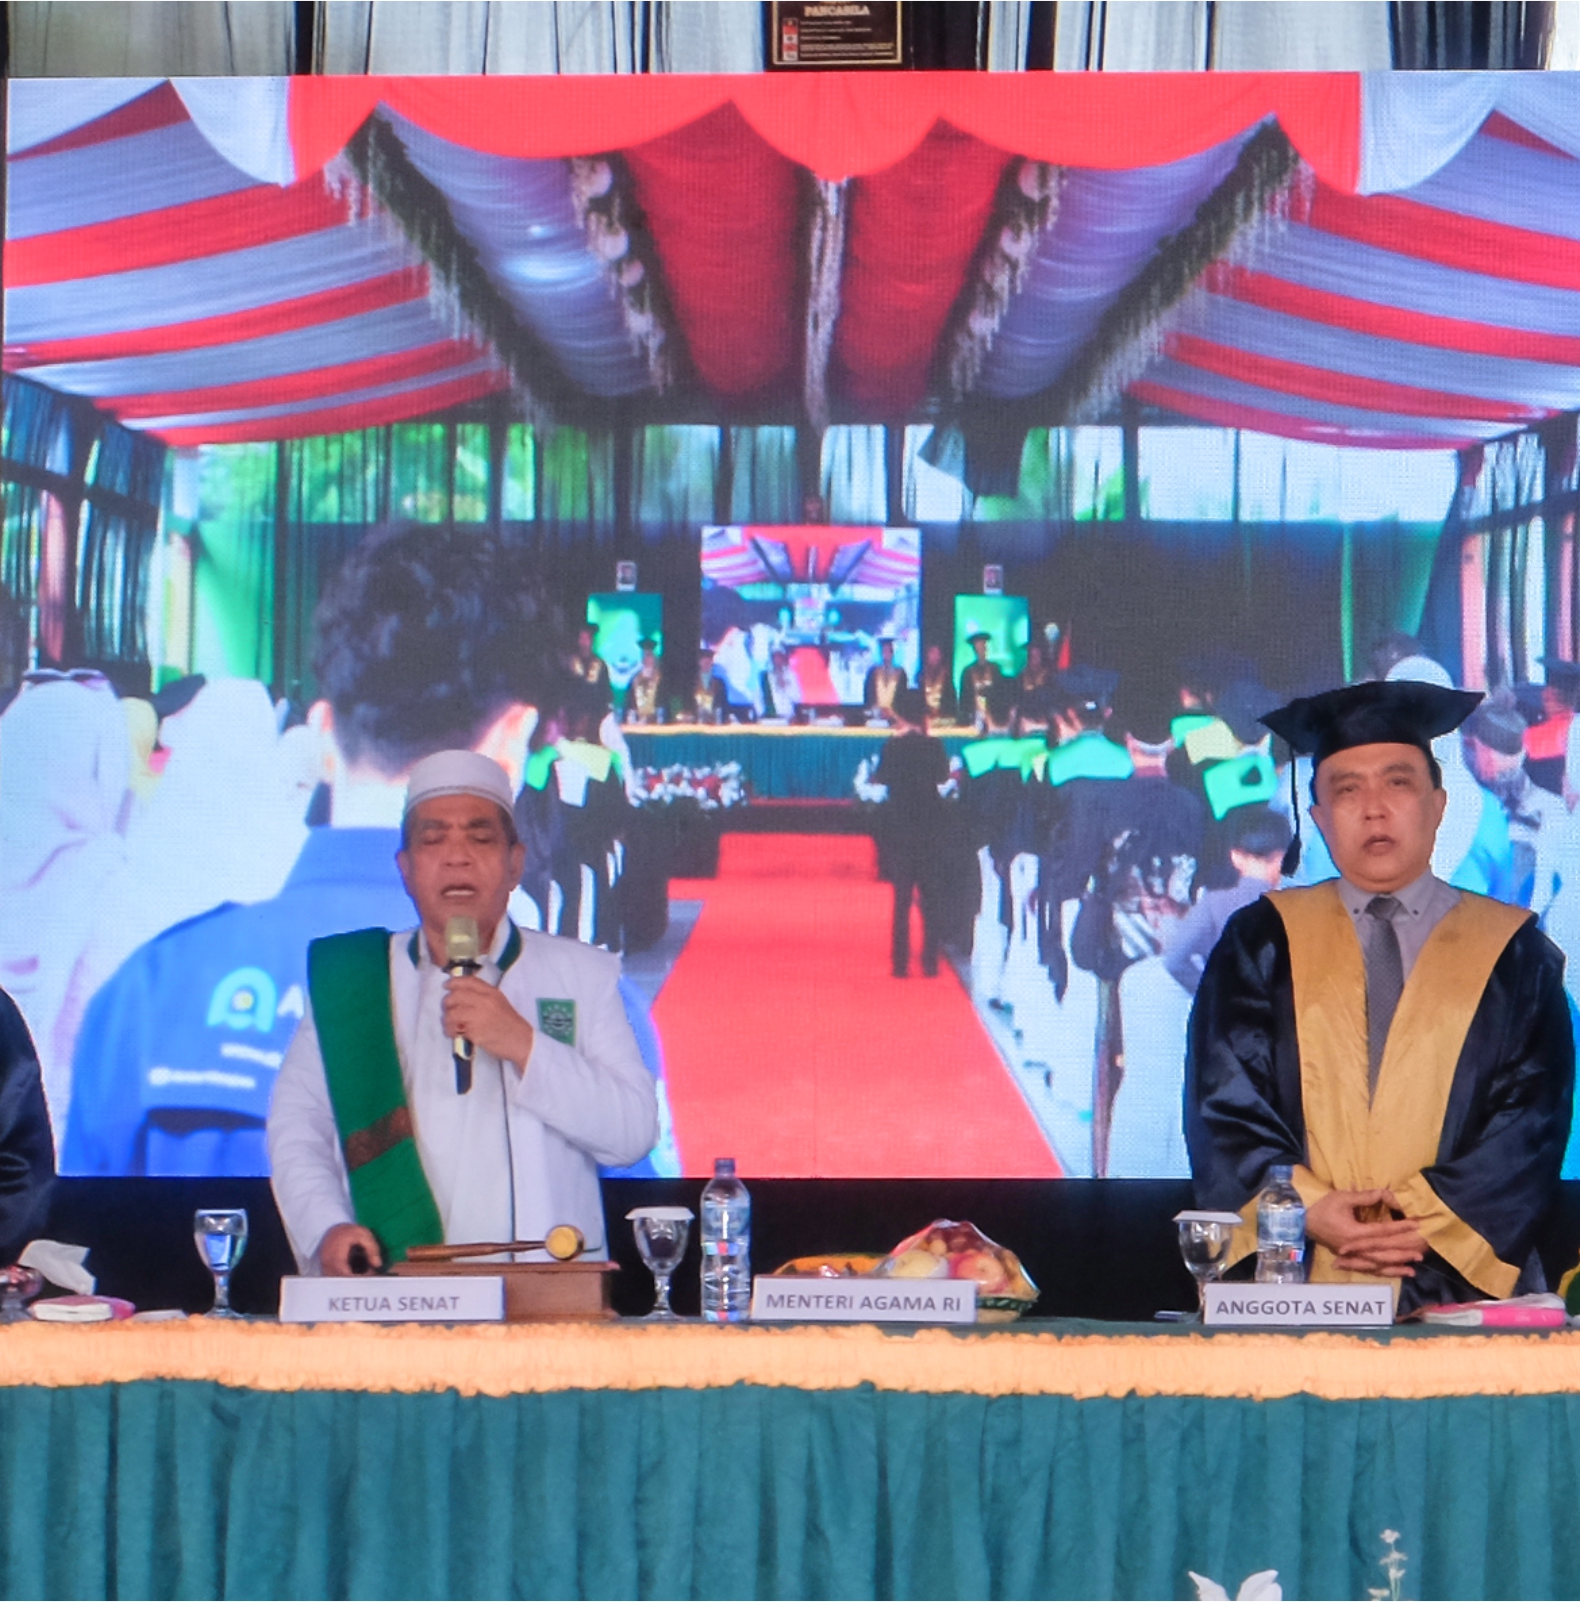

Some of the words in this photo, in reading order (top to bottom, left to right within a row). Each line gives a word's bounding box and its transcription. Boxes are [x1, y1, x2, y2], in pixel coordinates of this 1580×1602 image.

[328, 1296, 392, 1312] KETUA
[398, 1295, 460, 1312] SENAT
[766, 1294, 854, 1310] MENTERI
[860, 1295, 936, 1311] AGAMA
[942, 1296, 961, 1312] RI
[1215, 1300, 1316, 1315] ANGGOTA
[1323, 1300, 1386, 1316] SENAT
